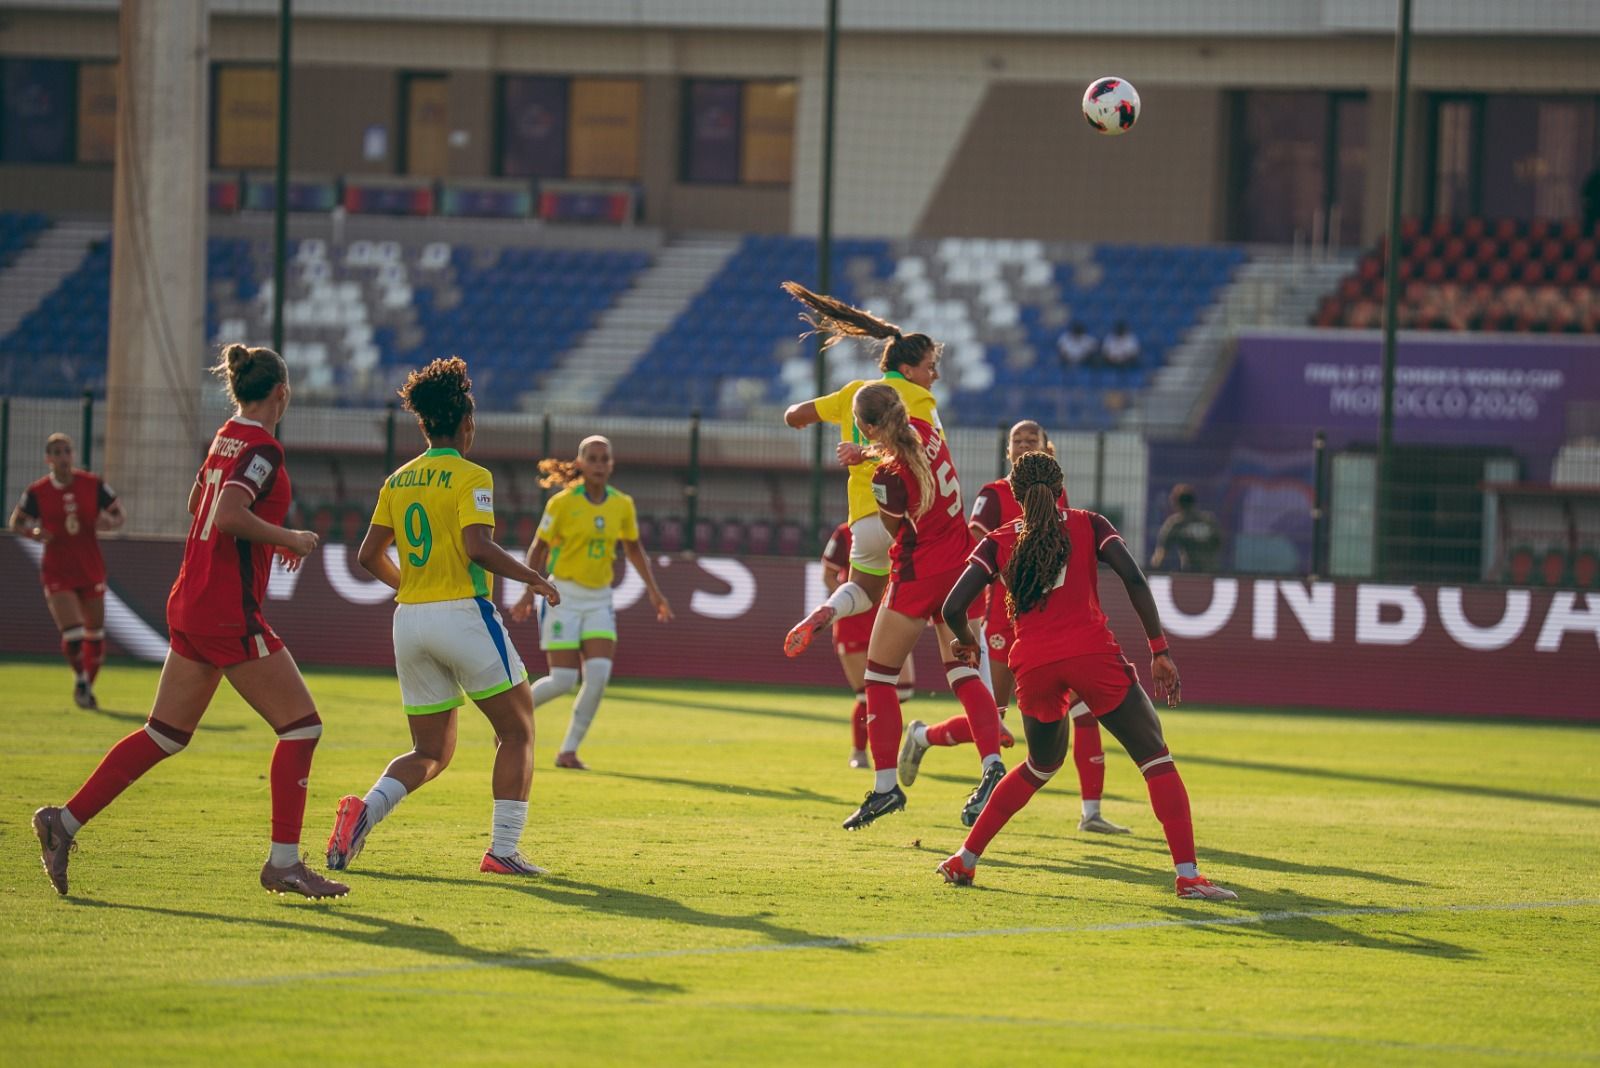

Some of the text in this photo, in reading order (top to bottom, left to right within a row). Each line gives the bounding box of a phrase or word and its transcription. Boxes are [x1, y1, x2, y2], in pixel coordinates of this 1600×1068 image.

[437, 470, 453, 489] M.
[936, 461, 961, 518] 5
[404, 502, 433, 568] 9
